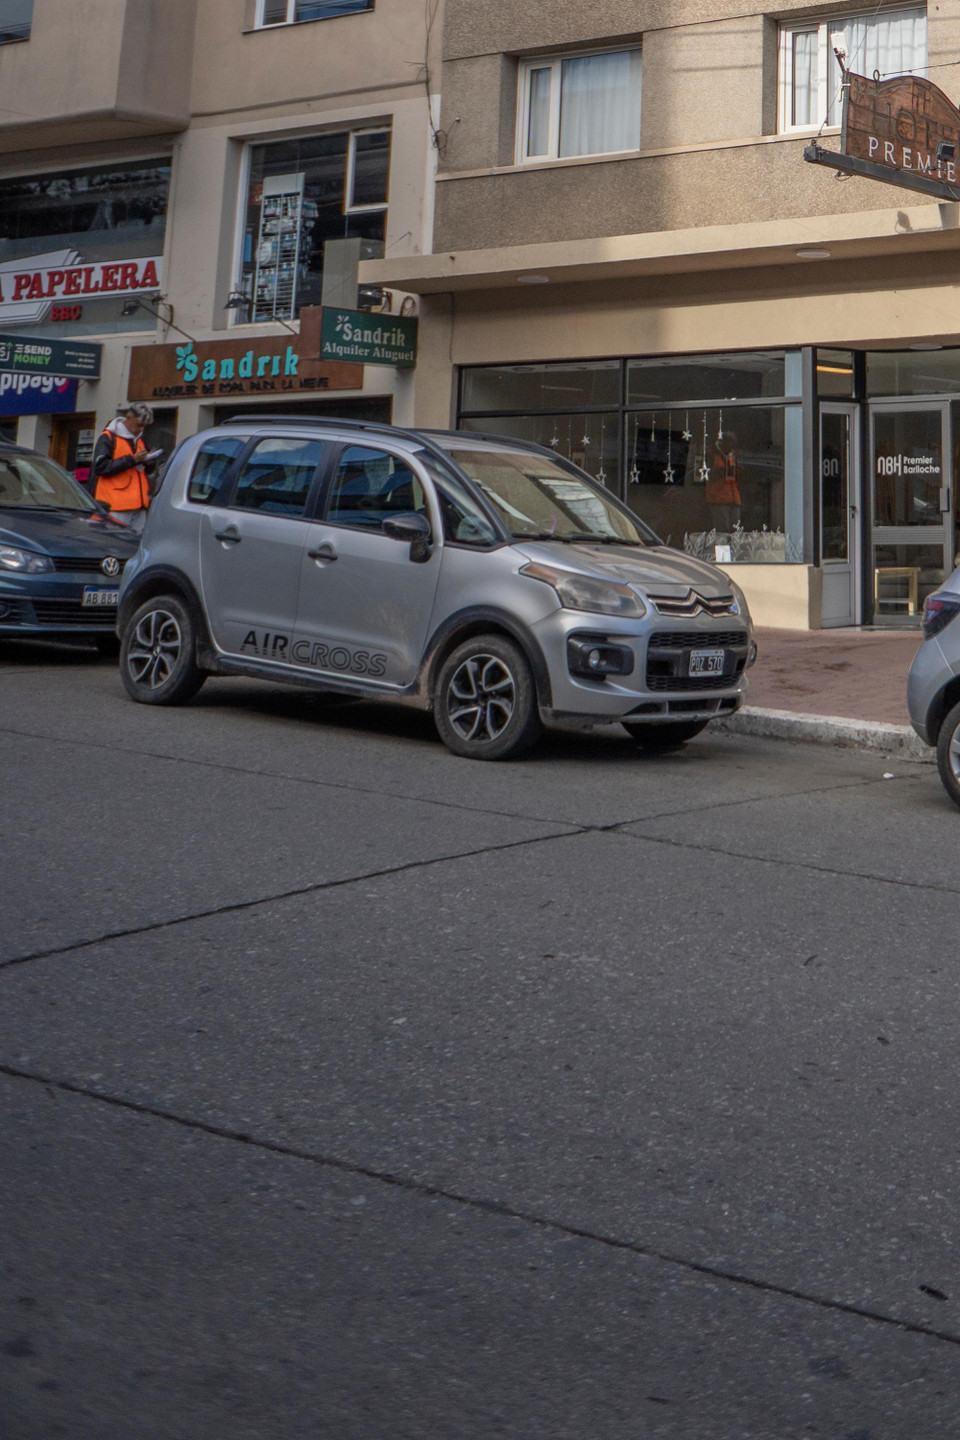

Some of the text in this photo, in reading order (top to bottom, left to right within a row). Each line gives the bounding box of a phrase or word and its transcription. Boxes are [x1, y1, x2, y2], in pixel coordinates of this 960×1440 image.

[11, 260, 160, 301] PAPELERA
[342, 323, 406, 347] Sandrik
[24, 345, 52, 355] SEND
[323, 342, 414, 361] Alquiler Aluguel
[14, 354, 51, 365] MONEY
[183, 346, 300, 382] Sandrik
[250, 380, 276, 391] PARA
[903, 456, 933, 465] Premier
[903, 465, 940, 474] Bariloche
[708, 657, 723, 671] 570
